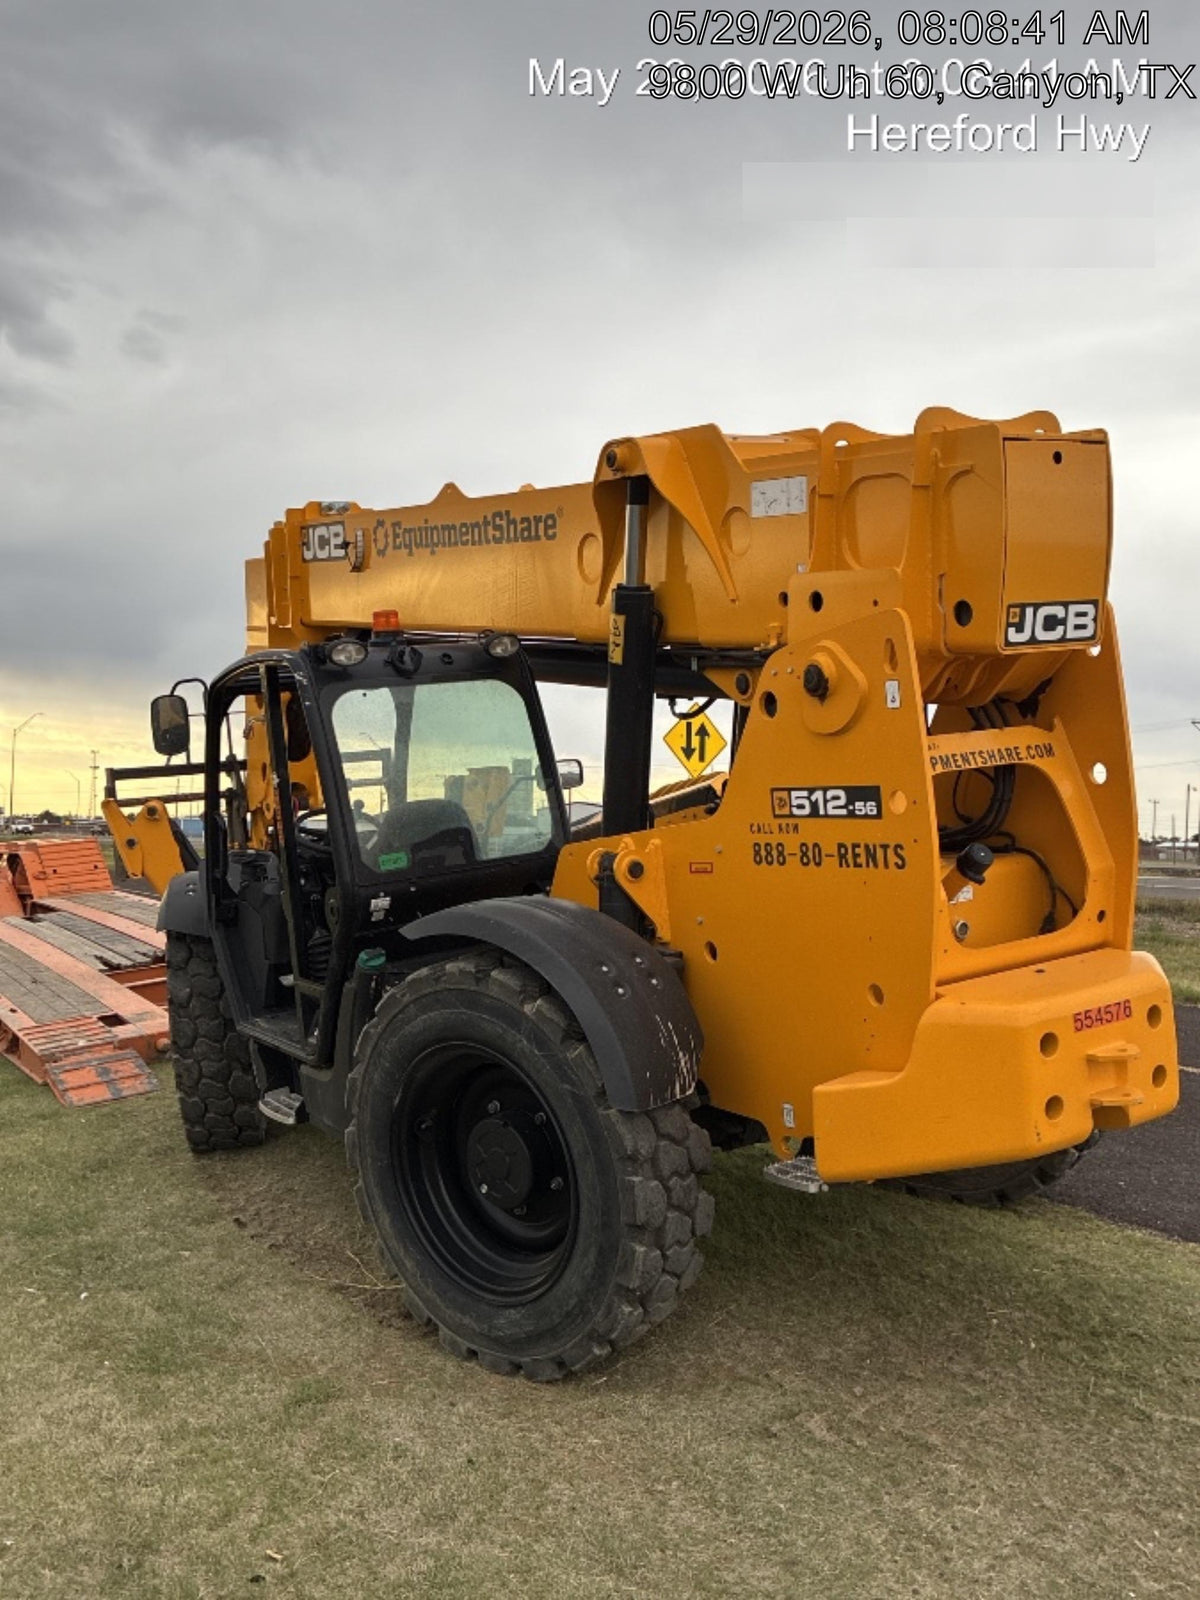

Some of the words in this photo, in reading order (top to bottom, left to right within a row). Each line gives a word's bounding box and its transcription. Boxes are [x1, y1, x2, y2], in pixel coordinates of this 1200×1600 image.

[303, 524, 346, 561] JCB
[1007, 603, 1097, 643] JCB
[790, 788, 878, 816] 512-56
[750, 822, 774, 834] CALL
[778, 822, 799, 834] NOW
[752, 842, 907, 870] 888-80-RENTS
[1073, 998, 1132, 1032] 554576
